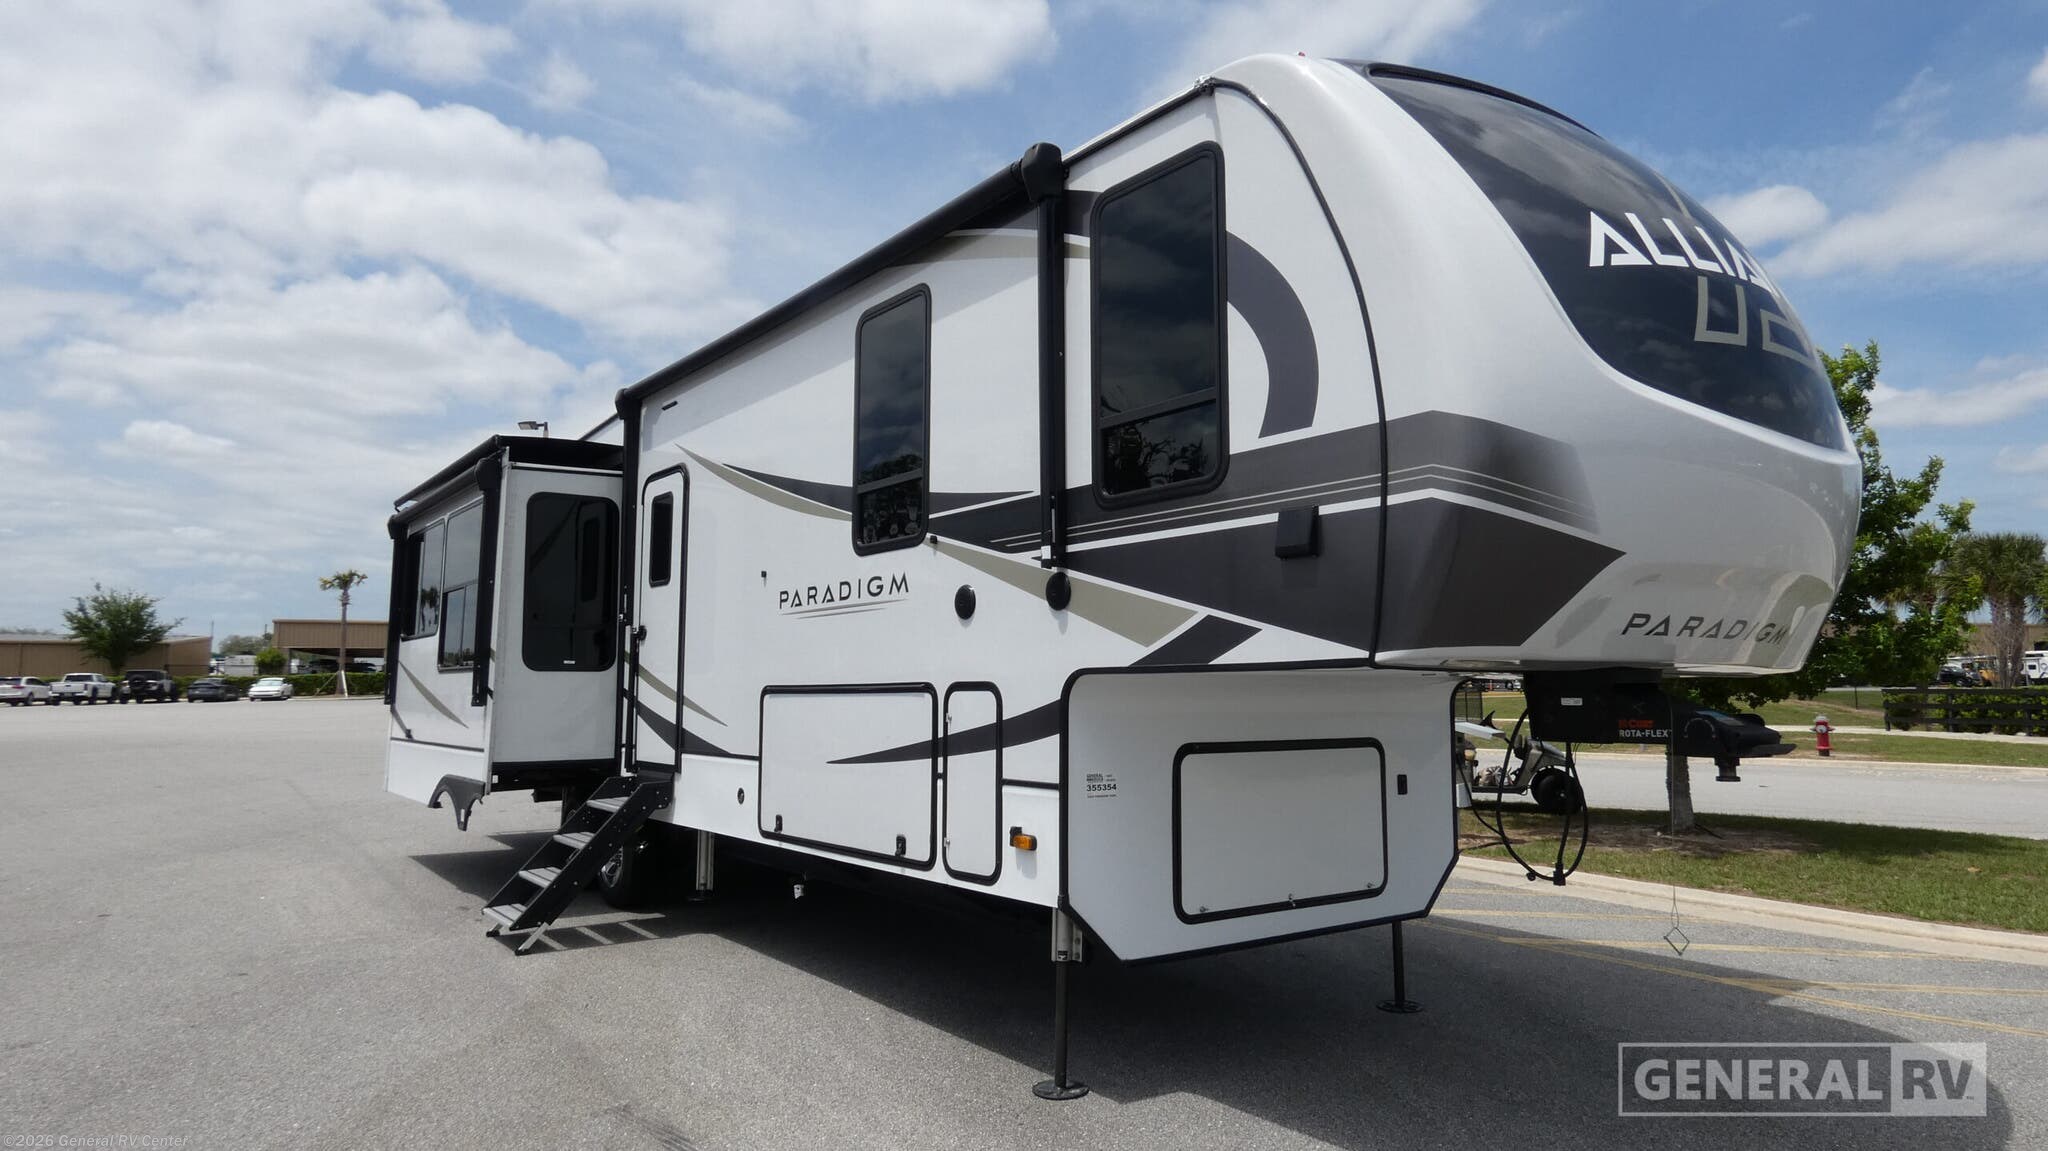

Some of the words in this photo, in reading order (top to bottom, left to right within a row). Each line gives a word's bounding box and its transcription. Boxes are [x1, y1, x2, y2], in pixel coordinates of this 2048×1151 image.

[1589, 211, 1779, 297] ALLIA
[779, 571, 909, 609] PARADIGM
[1621, 613, 1788, 645] PARADIGM
[1086, 783, 1117, 792] 355354
